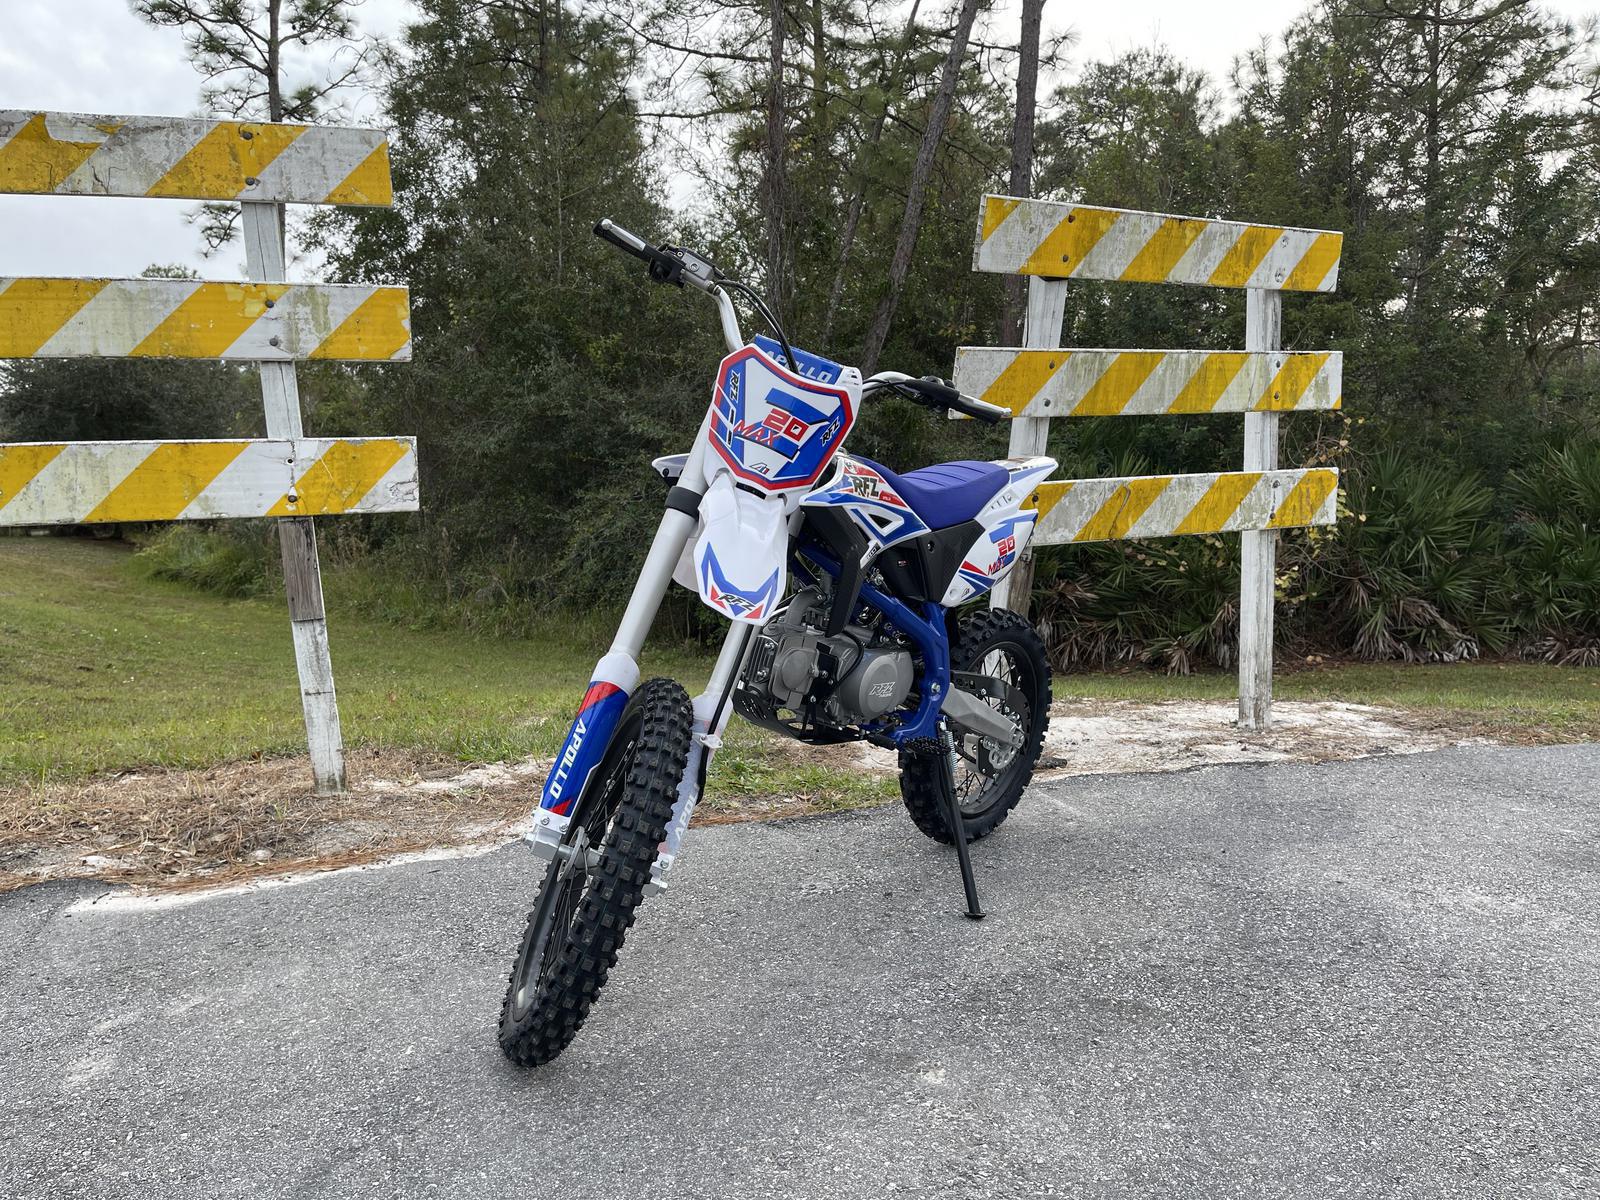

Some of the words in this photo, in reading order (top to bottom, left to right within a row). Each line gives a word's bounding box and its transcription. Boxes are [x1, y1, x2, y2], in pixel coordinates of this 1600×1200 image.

[766, 350, 832, 383] APLLO
[730, 369, 741, 403] RFZ
[733, 420, 780, 447] MAX
[762, 408, 809, 441] 20
[821, 416, 841, 447] RFZ
[850, 475, 880, 500] RFZ
[997, 535, 1015, 557] 20
[718, 594, 757, 612] RFZ
[549, 718, 587, 799] APOLLO
[675, 792, 699, 841] APOL
